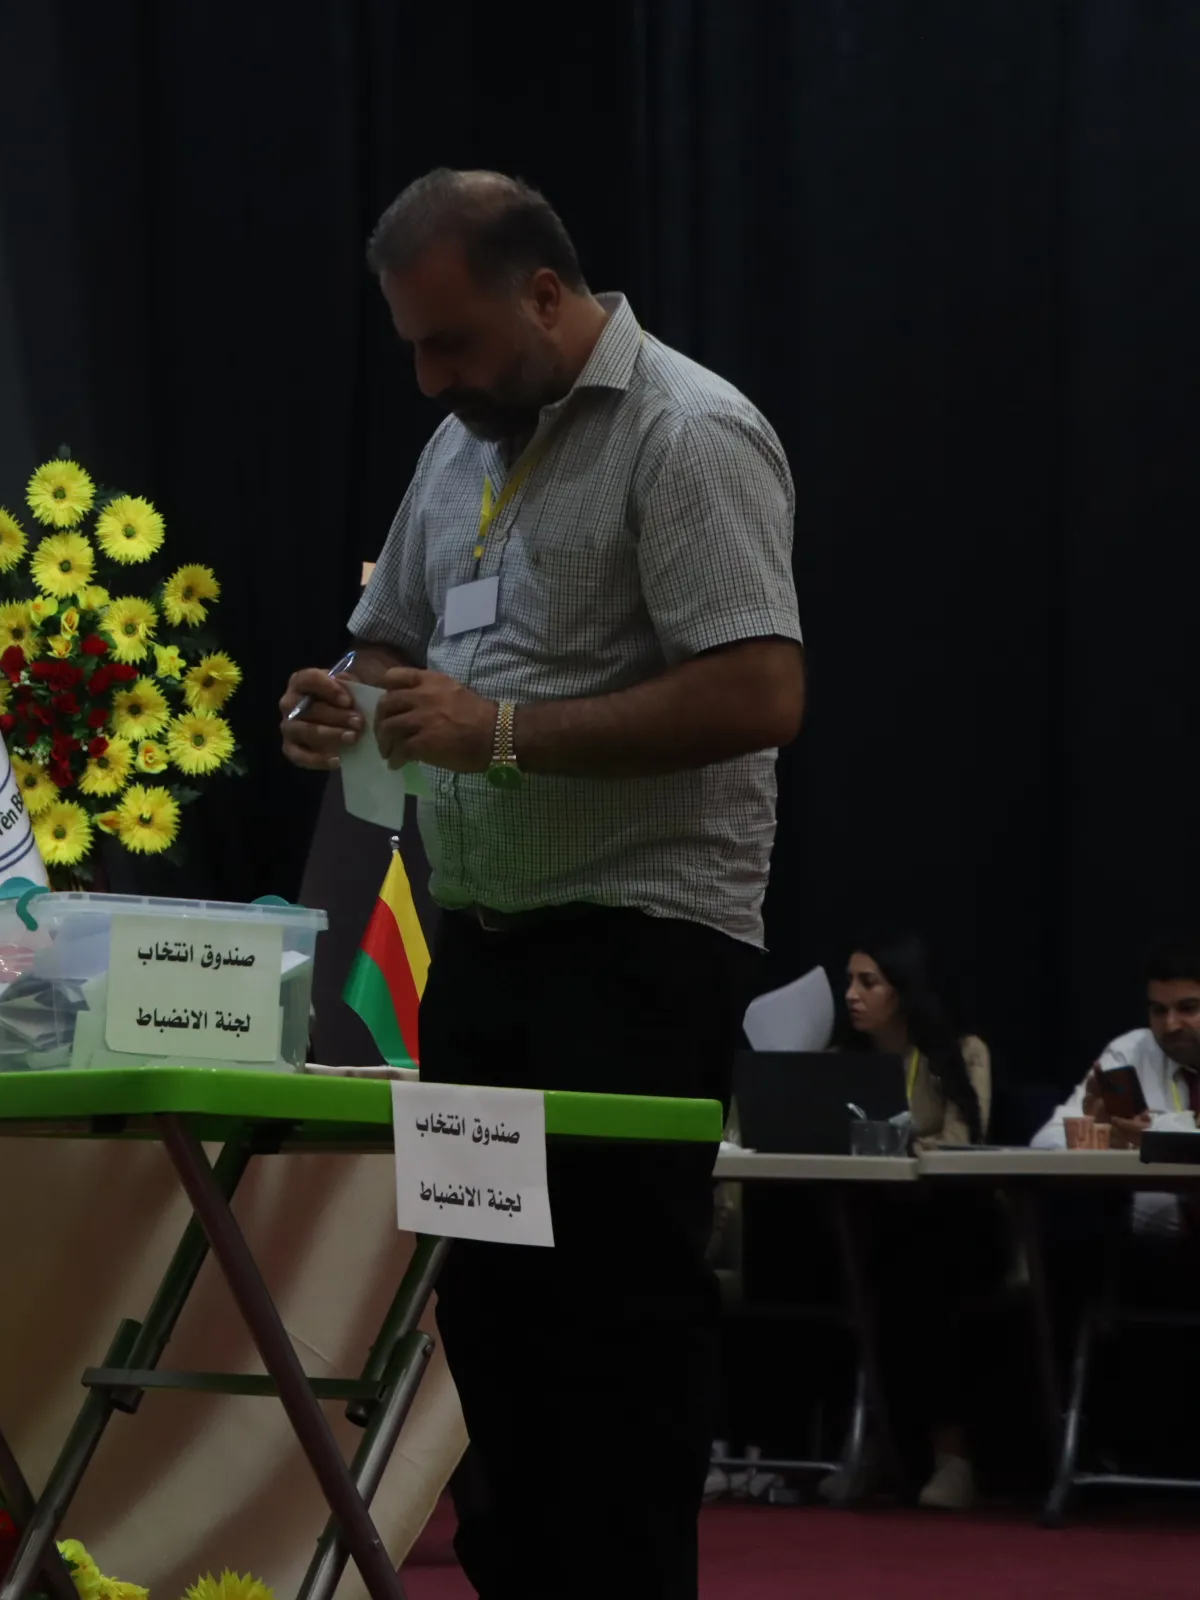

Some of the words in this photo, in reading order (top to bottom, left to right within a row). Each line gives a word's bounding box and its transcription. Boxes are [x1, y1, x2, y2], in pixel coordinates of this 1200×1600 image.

[138, 942, 193, 965] انتخاب
[200, 944, 255, 970] صندوق
[136, 1007, 207, 1033] الانضباط
[215, 1010, 251, 1037] لجنة
[416, 1112, 465, 1137] انتخاب
[472, 1118, 520, 1145] صندوق
[420, 1181, 481, 1210] الانضباط
[487, 1188, 522, 1217] لجنة
